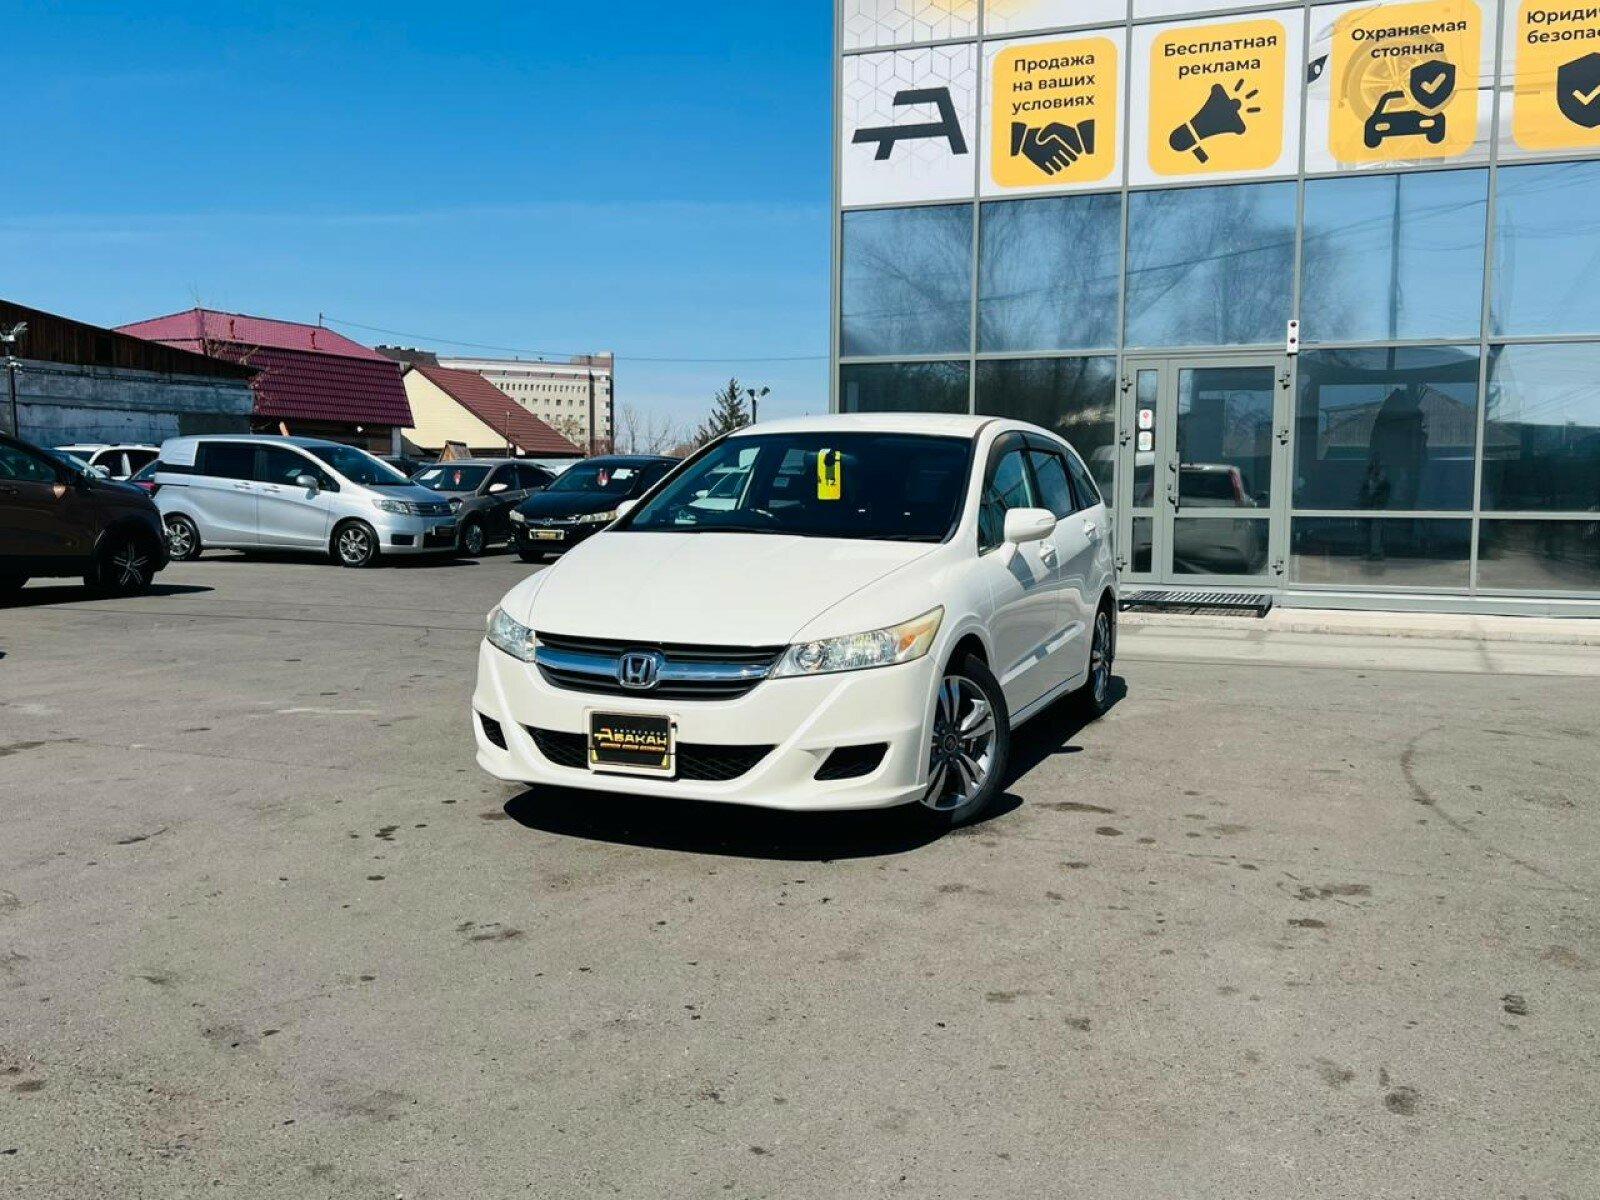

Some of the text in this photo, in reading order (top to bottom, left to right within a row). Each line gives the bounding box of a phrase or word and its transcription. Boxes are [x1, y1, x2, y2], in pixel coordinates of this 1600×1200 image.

[1527, 8, 1600, 25] Юриди
[1351, 20, 1467, 41] Охраняемая
[1164, 35, 1277, 57] Бесплатная
[1370, 43, 1445, 58] стоянка
[1014, 54, 1095, 74] Продажа
[1179, 58, 1261, 80] реклама
[1013, 74, 1096, 92] на ваших
[1011, 94, 1096, 116] условиях
